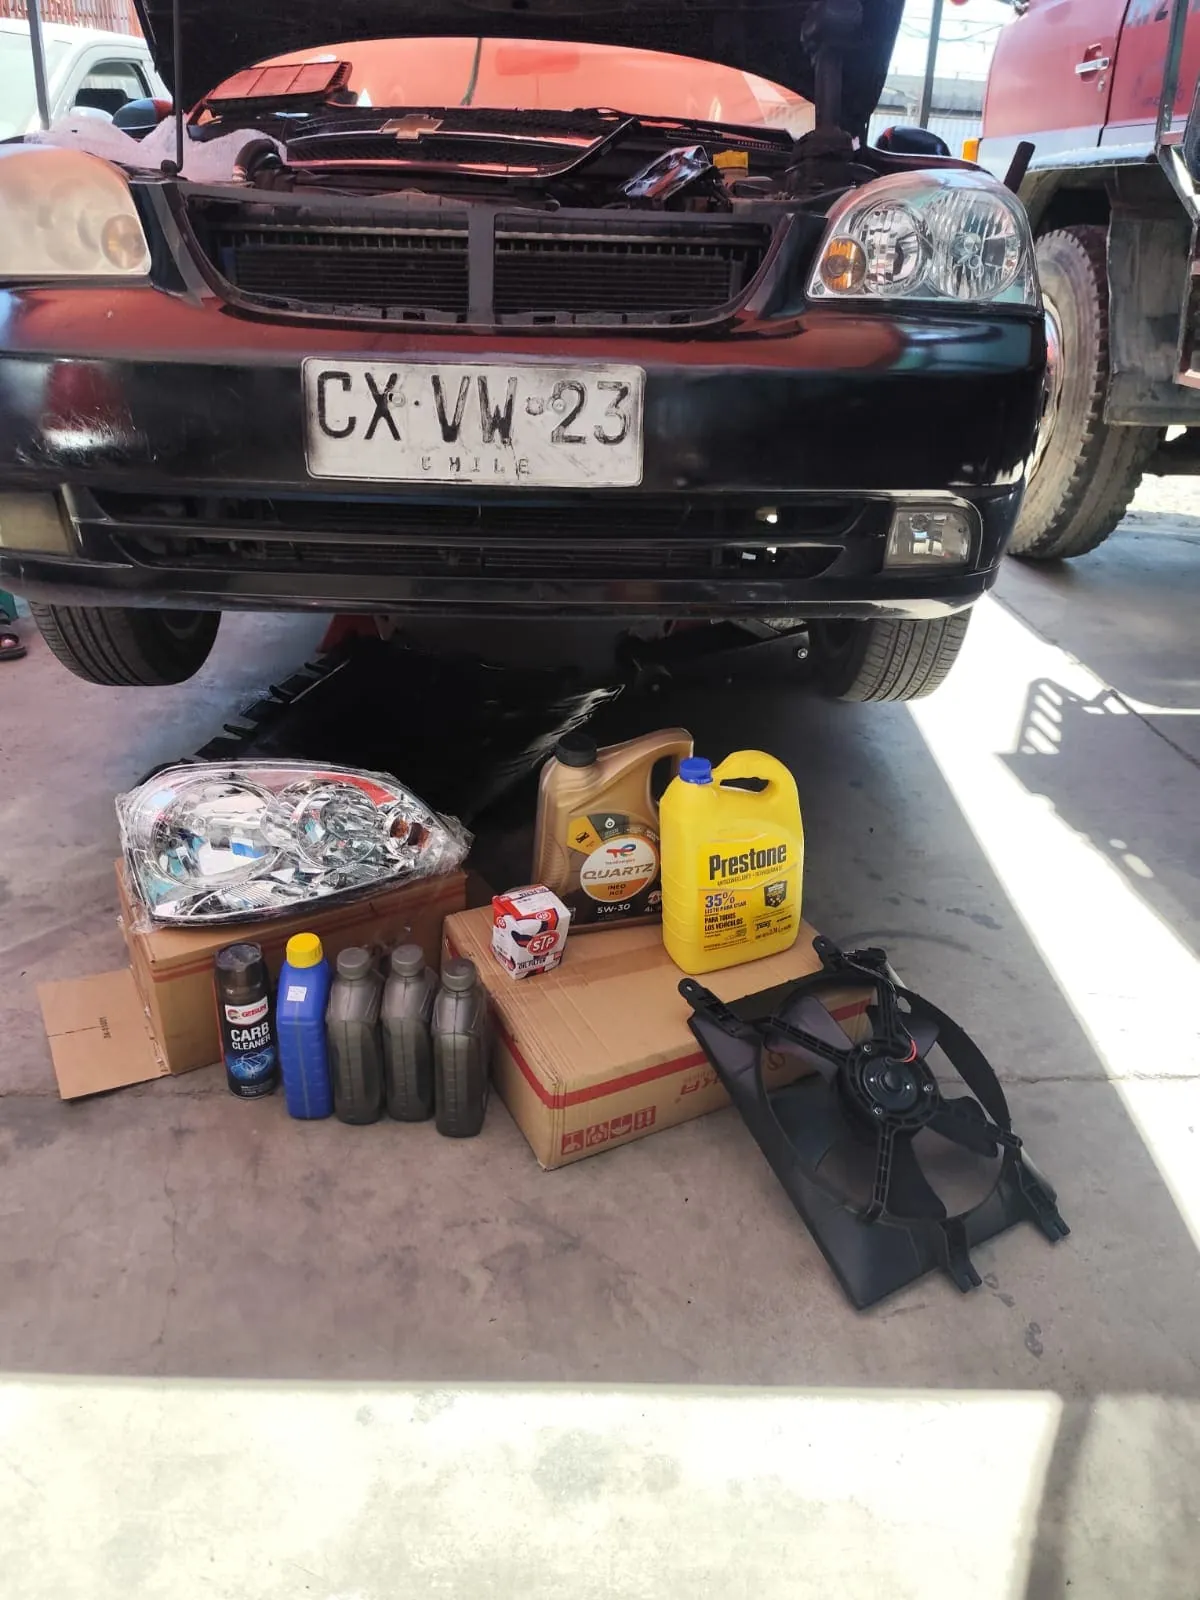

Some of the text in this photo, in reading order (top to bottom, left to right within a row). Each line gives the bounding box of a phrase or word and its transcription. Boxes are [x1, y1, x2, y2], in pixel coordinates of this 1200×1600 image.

[421, 456, 530, 475] CHILE
[582, 863, 654, 879] QUARTZ
[709, 844, 787, 880] Prestone
[705, 890, 735, 908] 35%
[597, 904, 631, 914] 5W-30
[532, 934, 555, 952] STP
[230, 1022, 270, 1042] CARB
[232, 1035, 271, 1050] CLEANER
